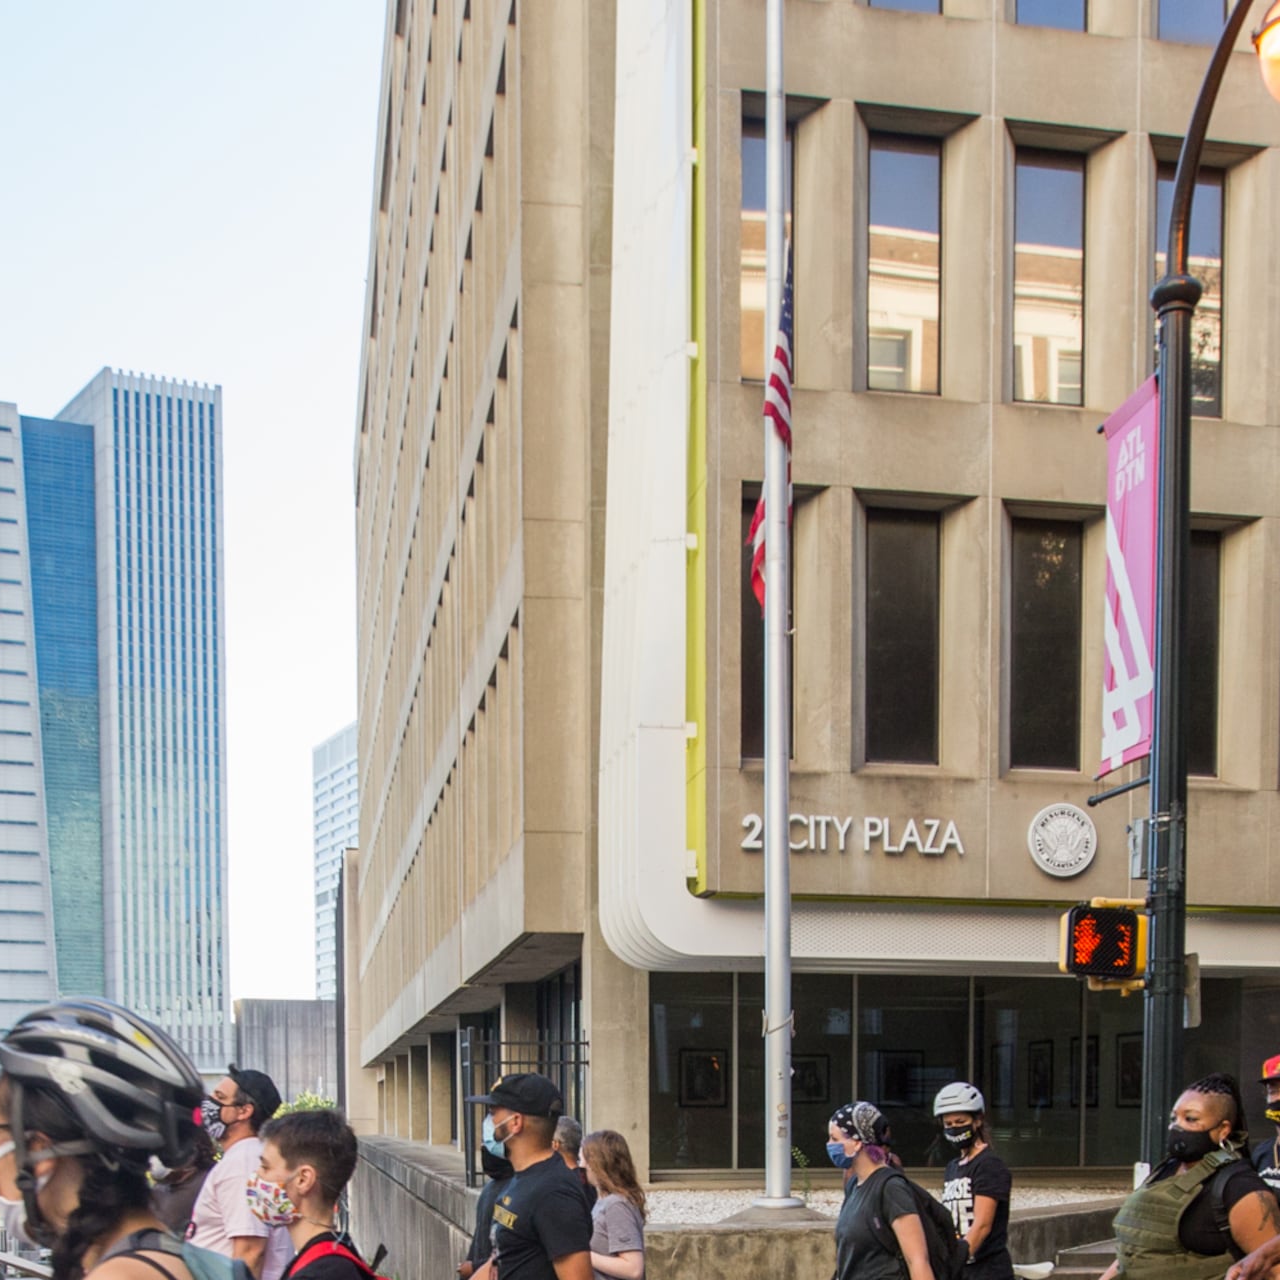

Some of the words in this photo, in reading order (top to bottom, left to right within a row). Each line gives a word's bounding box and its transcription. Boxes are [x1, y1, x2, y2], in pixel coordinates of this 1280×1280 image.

[1116, 425, 1145, 473] ATL
[1116, 450, 1145, 501] DTN
[740, 813, 763, 850] 2
[788, 814, 853, 851] CITY
[863, 816, 965, 855] PLAZA
